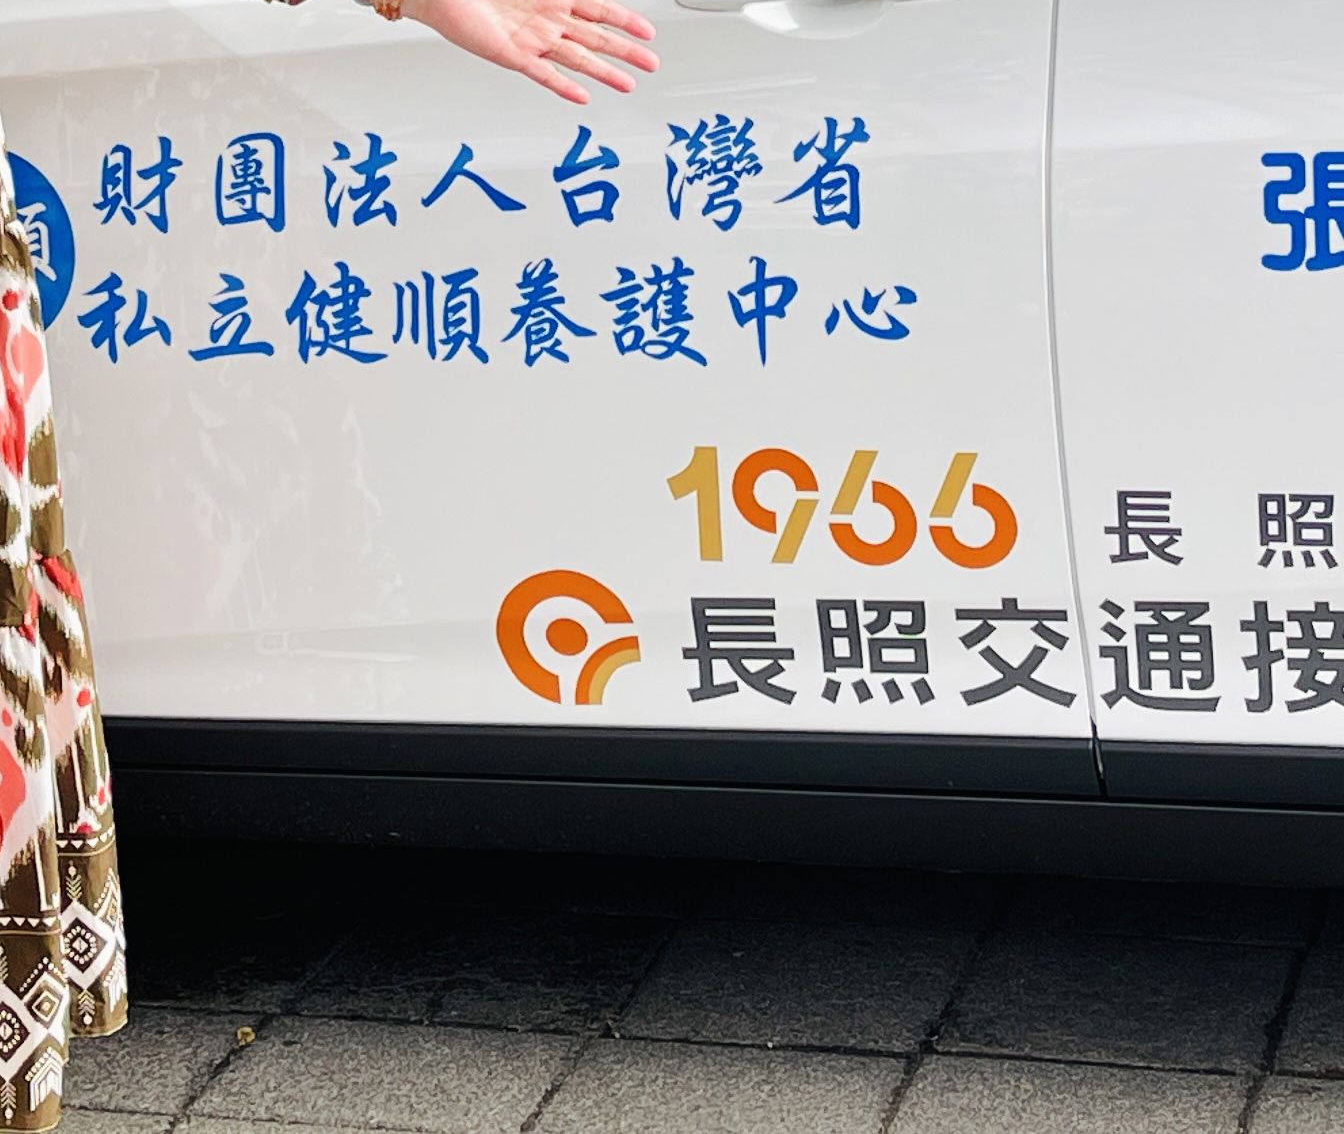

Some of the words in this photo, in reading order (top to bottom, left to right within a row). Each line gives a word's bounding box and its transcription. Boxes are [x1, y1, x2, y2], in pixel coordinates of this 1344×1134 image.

[94, 114, 871, 234] 財團法人台灣省
[78, 256, 918, 367] 私立健順養護中心
[667, 446, 1019, 570] 1966
